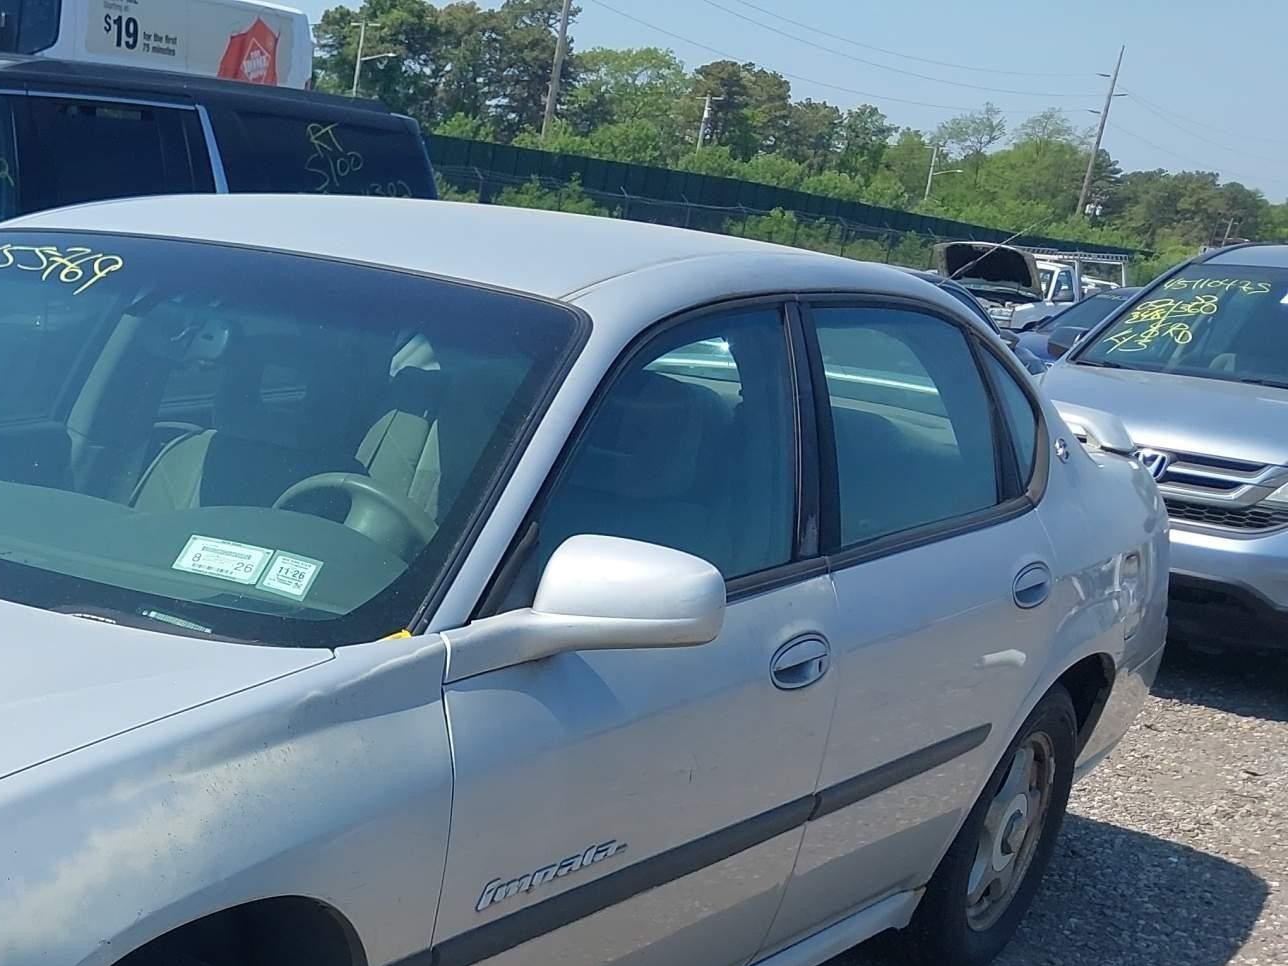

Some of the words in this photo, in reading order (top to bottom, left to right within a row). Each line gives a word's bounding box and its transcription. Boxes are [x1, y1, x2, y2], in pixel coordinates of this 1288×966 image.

[103, 13, 139, 50] $19
[191, 552, 202, 563] 8
[233, 561, 255, 574] 26
[474, 839, 626, 913] Impala
